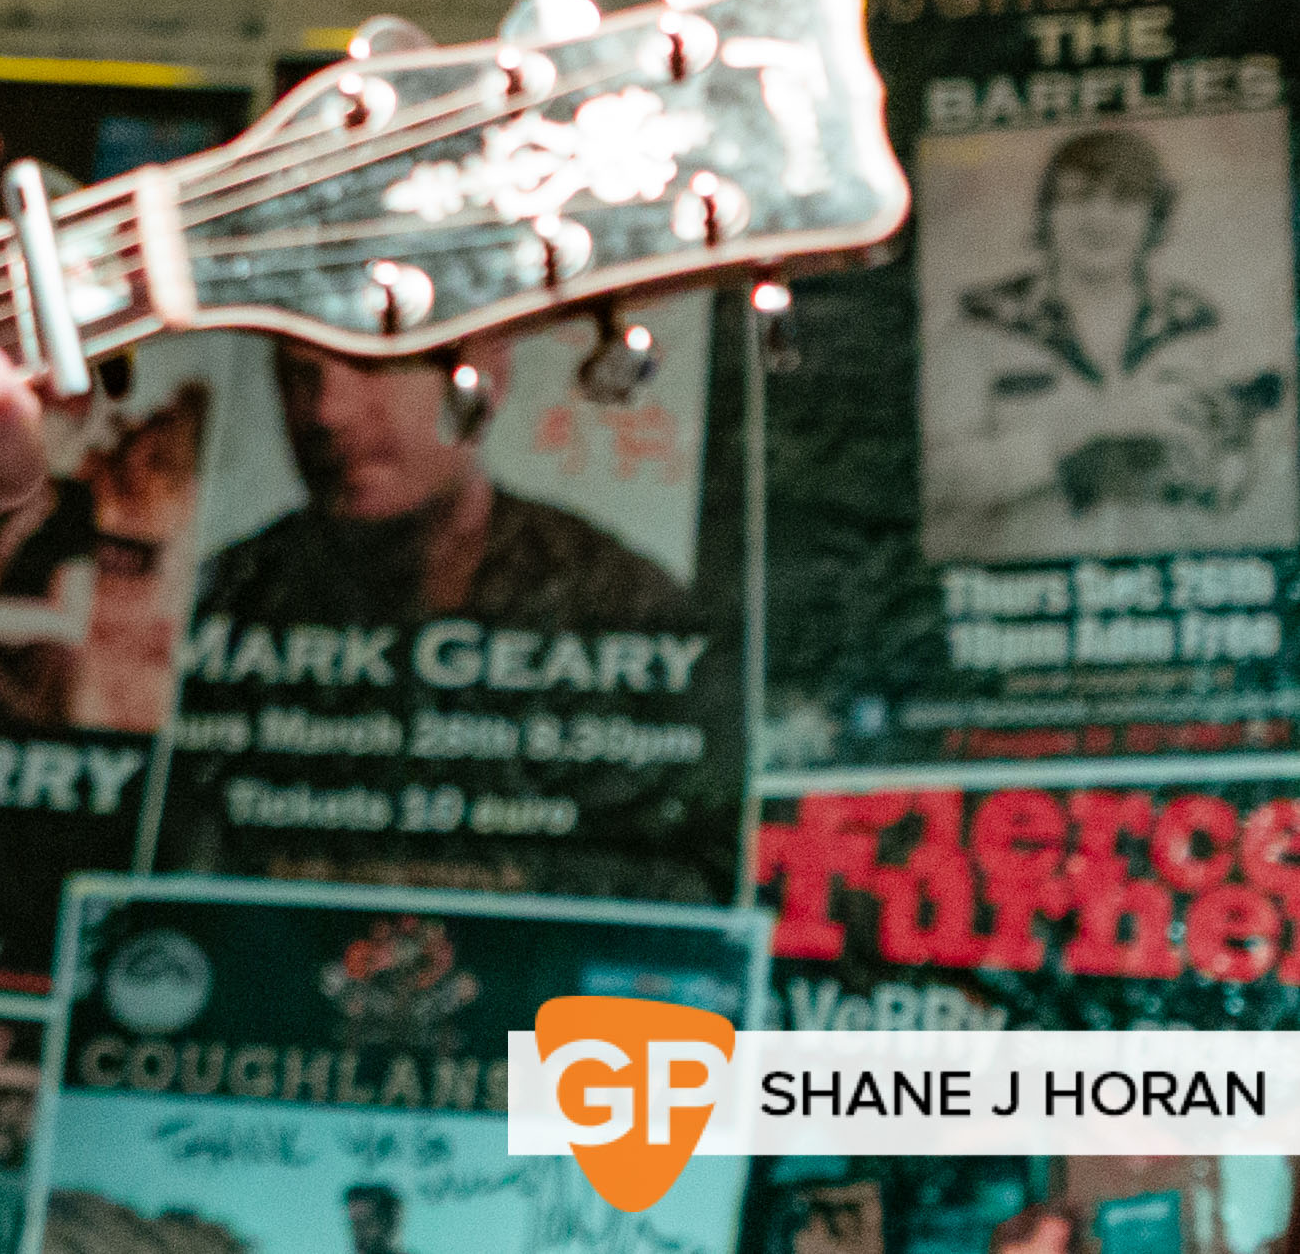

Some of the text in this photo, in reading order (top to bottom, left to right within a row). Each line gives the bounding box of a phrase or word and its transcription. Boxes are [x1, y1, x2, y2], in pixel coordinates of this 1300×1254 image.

[1024, 4, 1175, 66] THE
[924, 54, 1283, 133] BARFLIES
[179, 614, 709, 692] MARK GEARY
[1180, 610, 1282, 660] Free
[256, 708, 403, 752] March
[225, 776, 579, 837] Tickets 10 euro
[755, 822, 1300, 984] Turne
